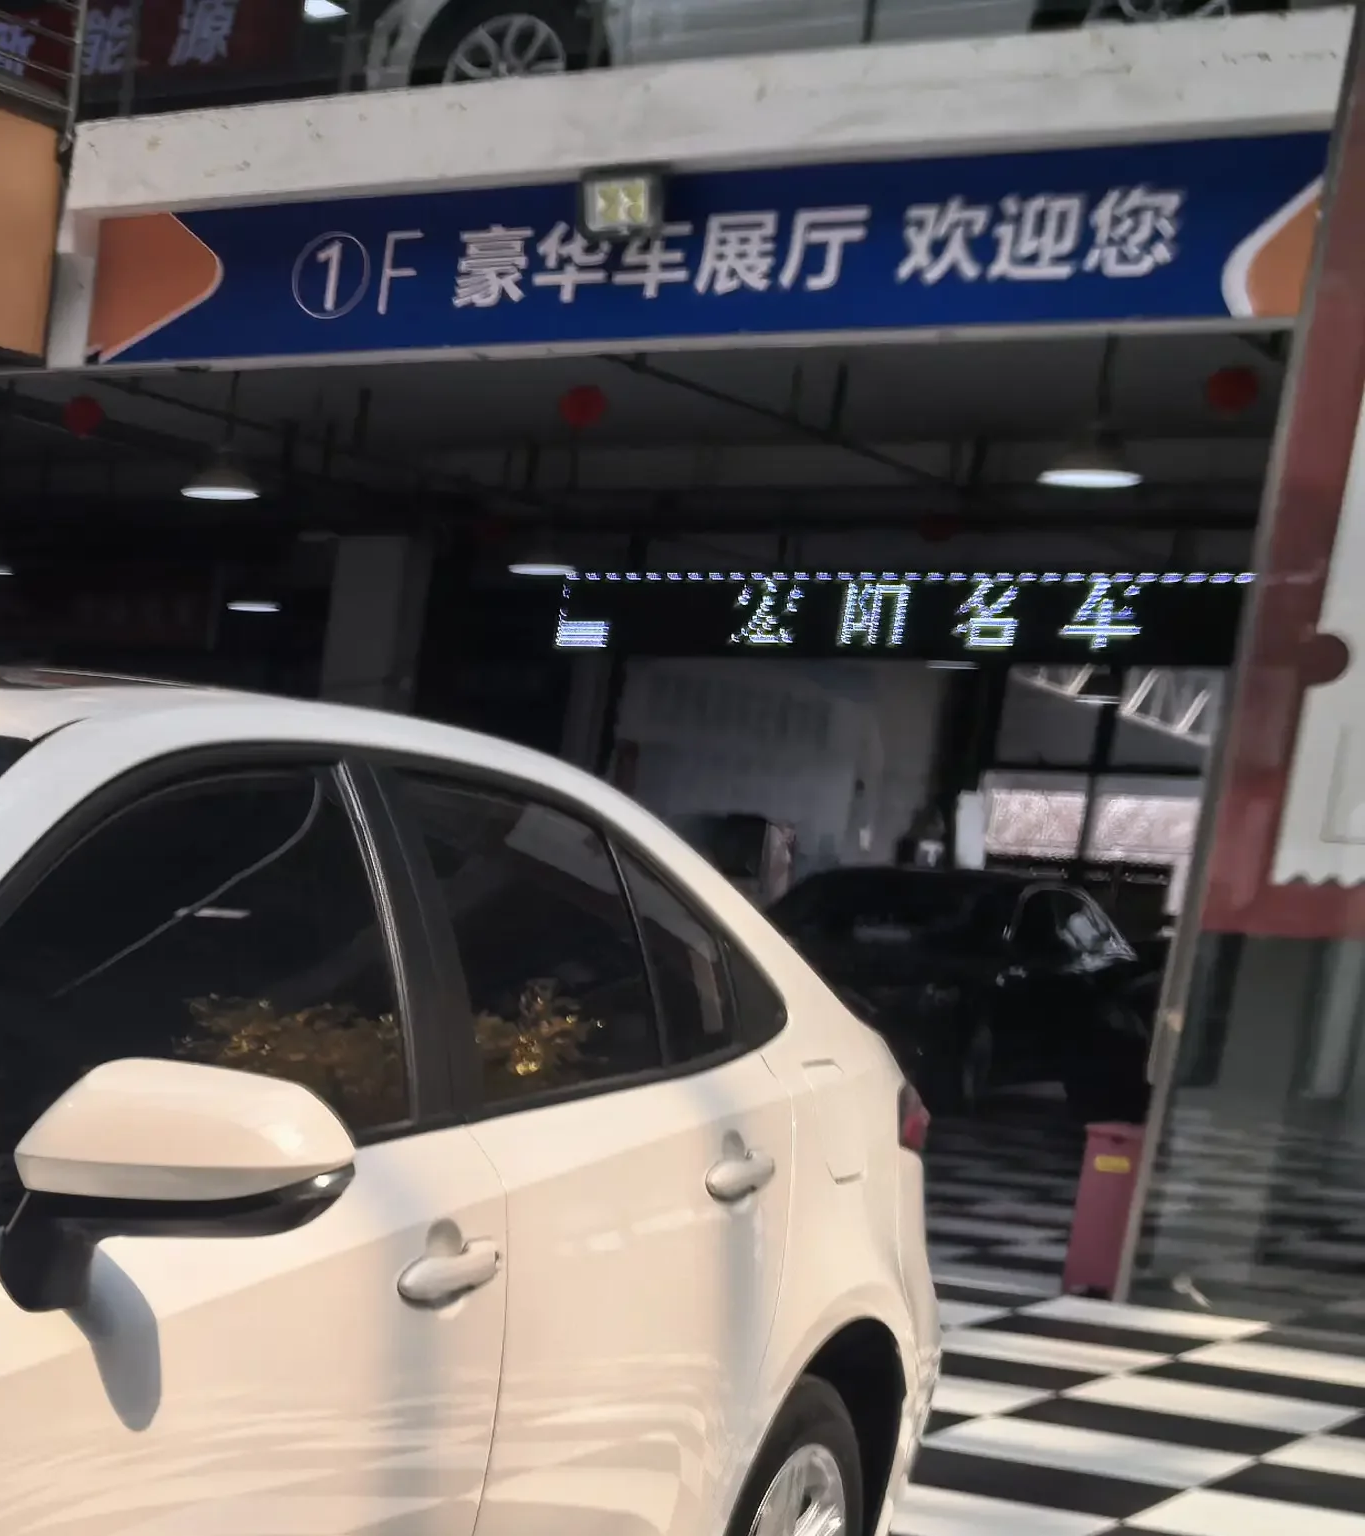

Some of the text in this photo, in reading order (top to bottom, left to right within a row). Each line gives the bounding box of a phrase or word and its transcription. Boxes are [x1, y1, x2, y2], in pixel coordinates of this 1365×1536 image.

[452, 203, 870, 308] 豪华车展厅
[897, 184, 1184, 285] 欢迎您
